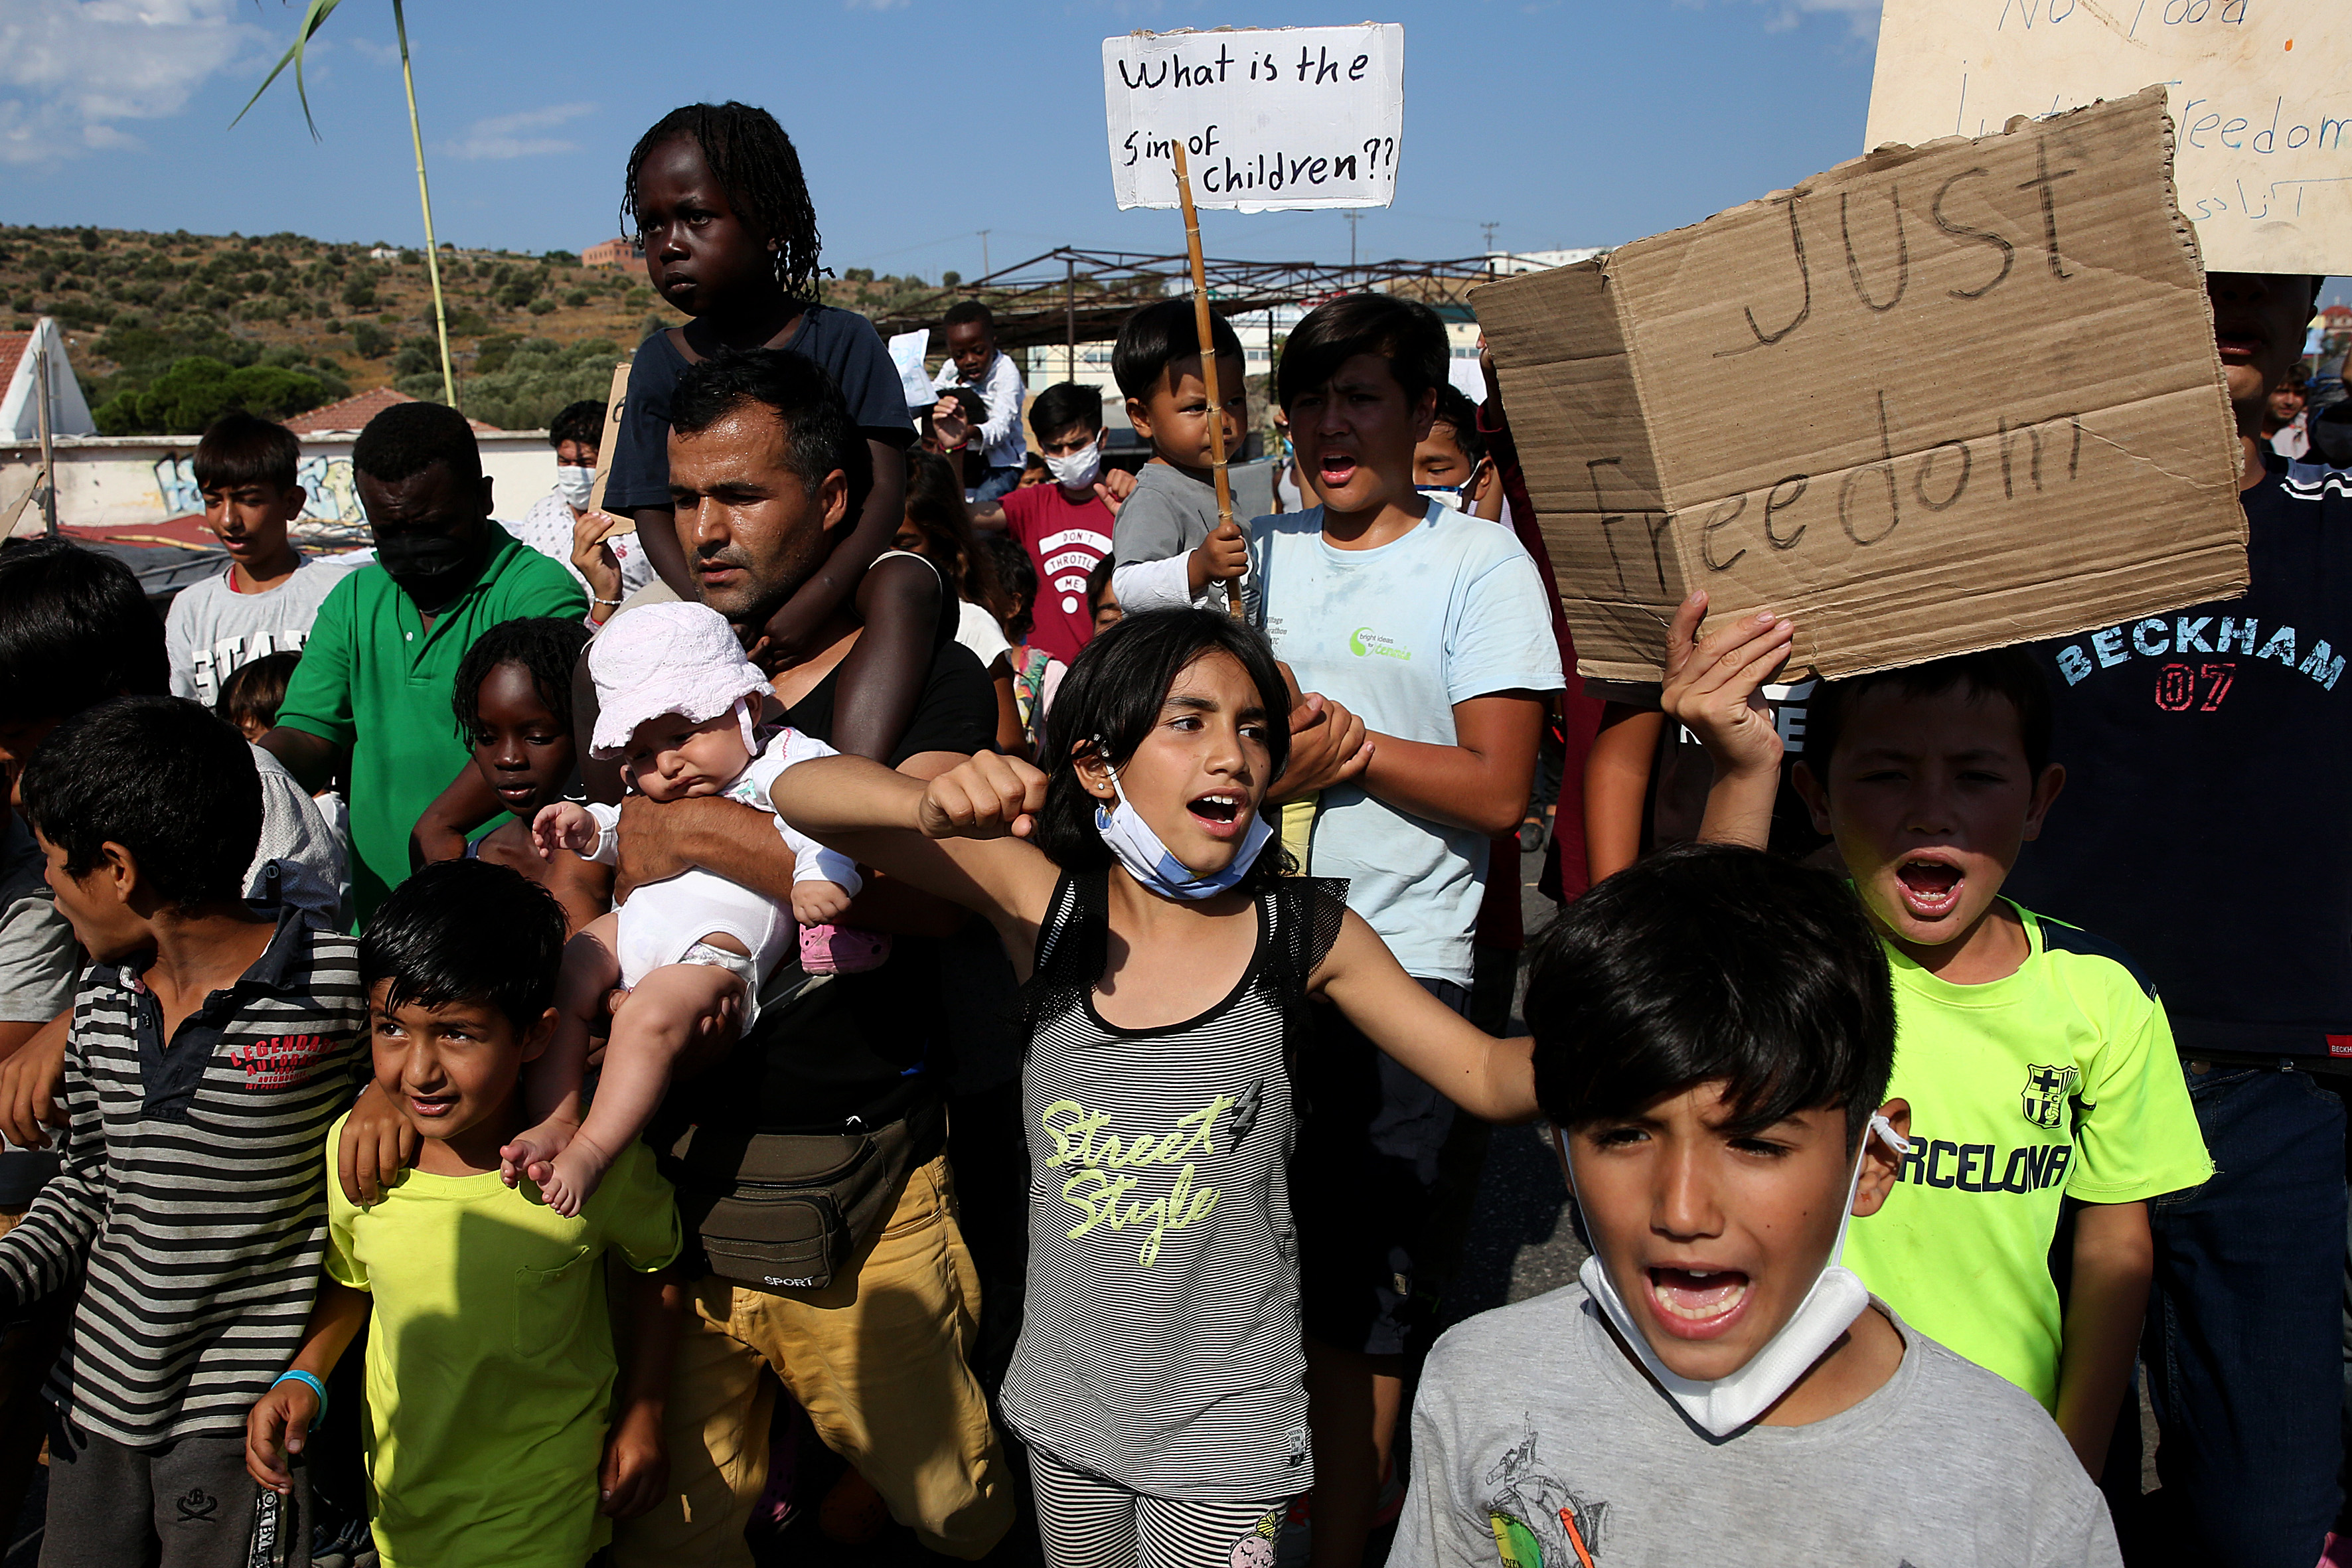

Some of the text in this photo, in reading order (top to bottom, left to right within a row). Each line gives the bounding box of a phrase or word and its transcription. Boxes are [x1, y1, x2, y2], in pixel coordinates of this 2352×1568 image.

[1118, 42, 1370, 90] What is the
[1188, 124, 1221, 157] of
[2161, 79, 2352, 154] reedom
[1586, 389, 2082, 599] Freedom
[1062, 532, 1094, 544] DON'T
[1063, 579, 1081, 589] ME
[1359, 633, 1394, 644] bright ideas
[2055, 615, 2347, 692] BECKHAM
[2155, 663, 2237, 712] 07
[230, 1034, 339, 1068] LEGENDARY
[1042, 1093, 1236, 1169] Street
[1062, 1162, 1221, 1268] Style
[763, 1275, 814, 1287] SPORT
